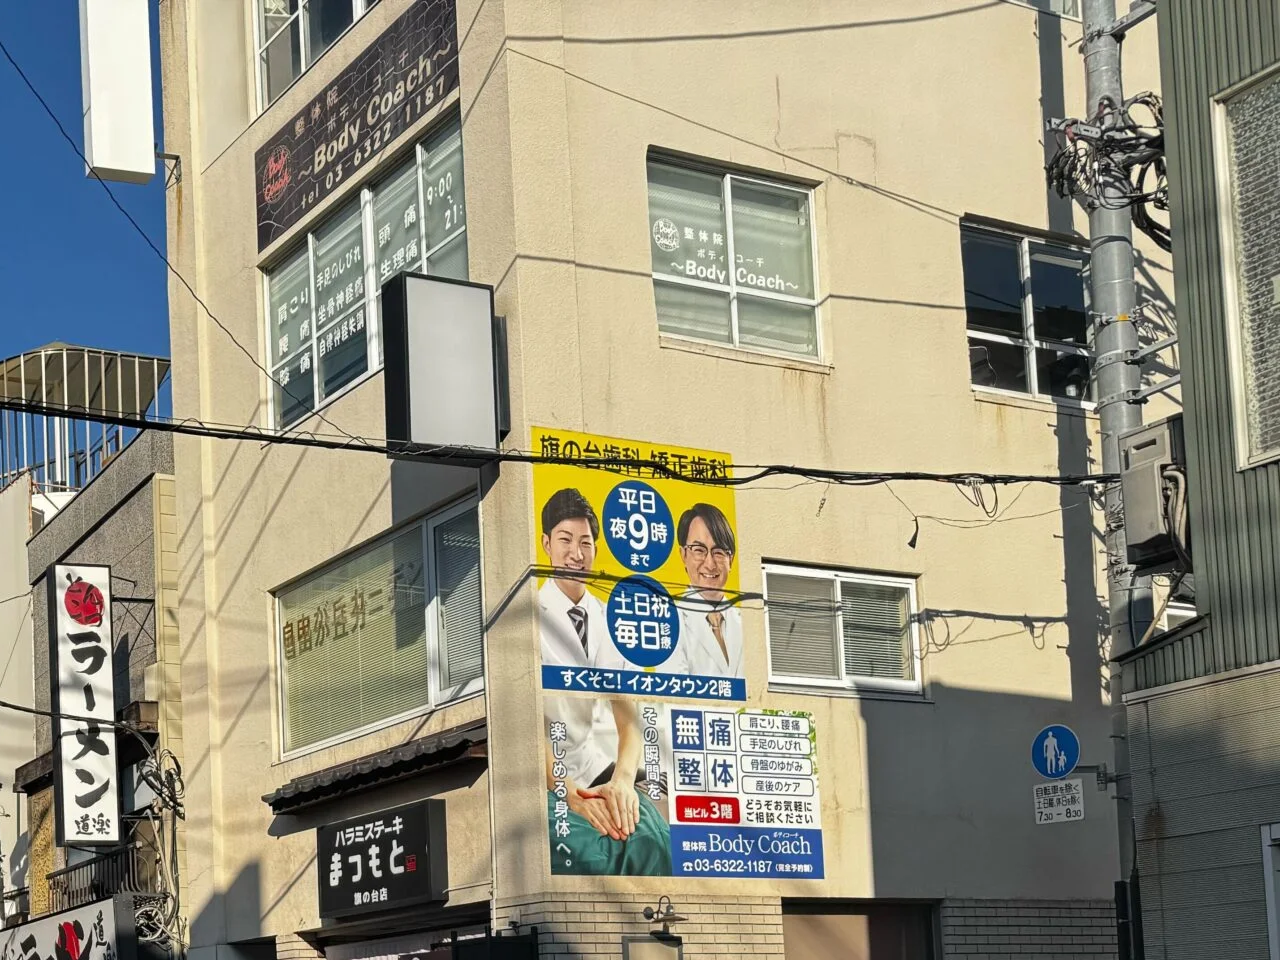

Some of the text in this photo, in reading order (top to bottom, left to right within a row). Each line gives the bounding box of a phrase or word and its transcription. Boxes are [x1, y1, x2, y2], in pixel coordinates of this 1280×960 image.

[301, 75, 445, 209] tel 03-6322-1187
[427, 172, 453, 205] 9:00
[684, 226, 723, 246] 整体院
[316, 245, 361, 292] 手足のしびれ
[278, 288, 309, 325] 肩こり
[618, 487, 656, 514] 平日
[609, 513, 668, 550] 夜9時
[630, 553, 650, 567] まで
[614, 590, 671, 618] 土日祝
[627, 674, 732, 697] イオンタウン2階
[67, 631, 110, 808] ラーメン
[749, 716, 801, 732] 肩こり、腰痛
[643, 707, 661, 801] その瞬間を
[749, 737, 802, 752] 手足のしびれ
[750, 758, 803, 773] 骨盤のゆがみ
[550, 722, 572, 867] 楽しめる身体へ。
[755, 780, 801, 792] 産後のケア
[745, 799, 813, 813] どうぞお気軽に
[74, 813, 111, 836] 道楽
[746, 811, 814, 825] ご相談ください
[335, 815, 404, 848] ハラミステーキ
[682, 833, 812, 855] 整体院 Body Coach
[329, 839, 405, 887] まつもと
[694, 859, 773, 873] 03-6322-1187
[353, 887, 388, 906] 旗の台店
